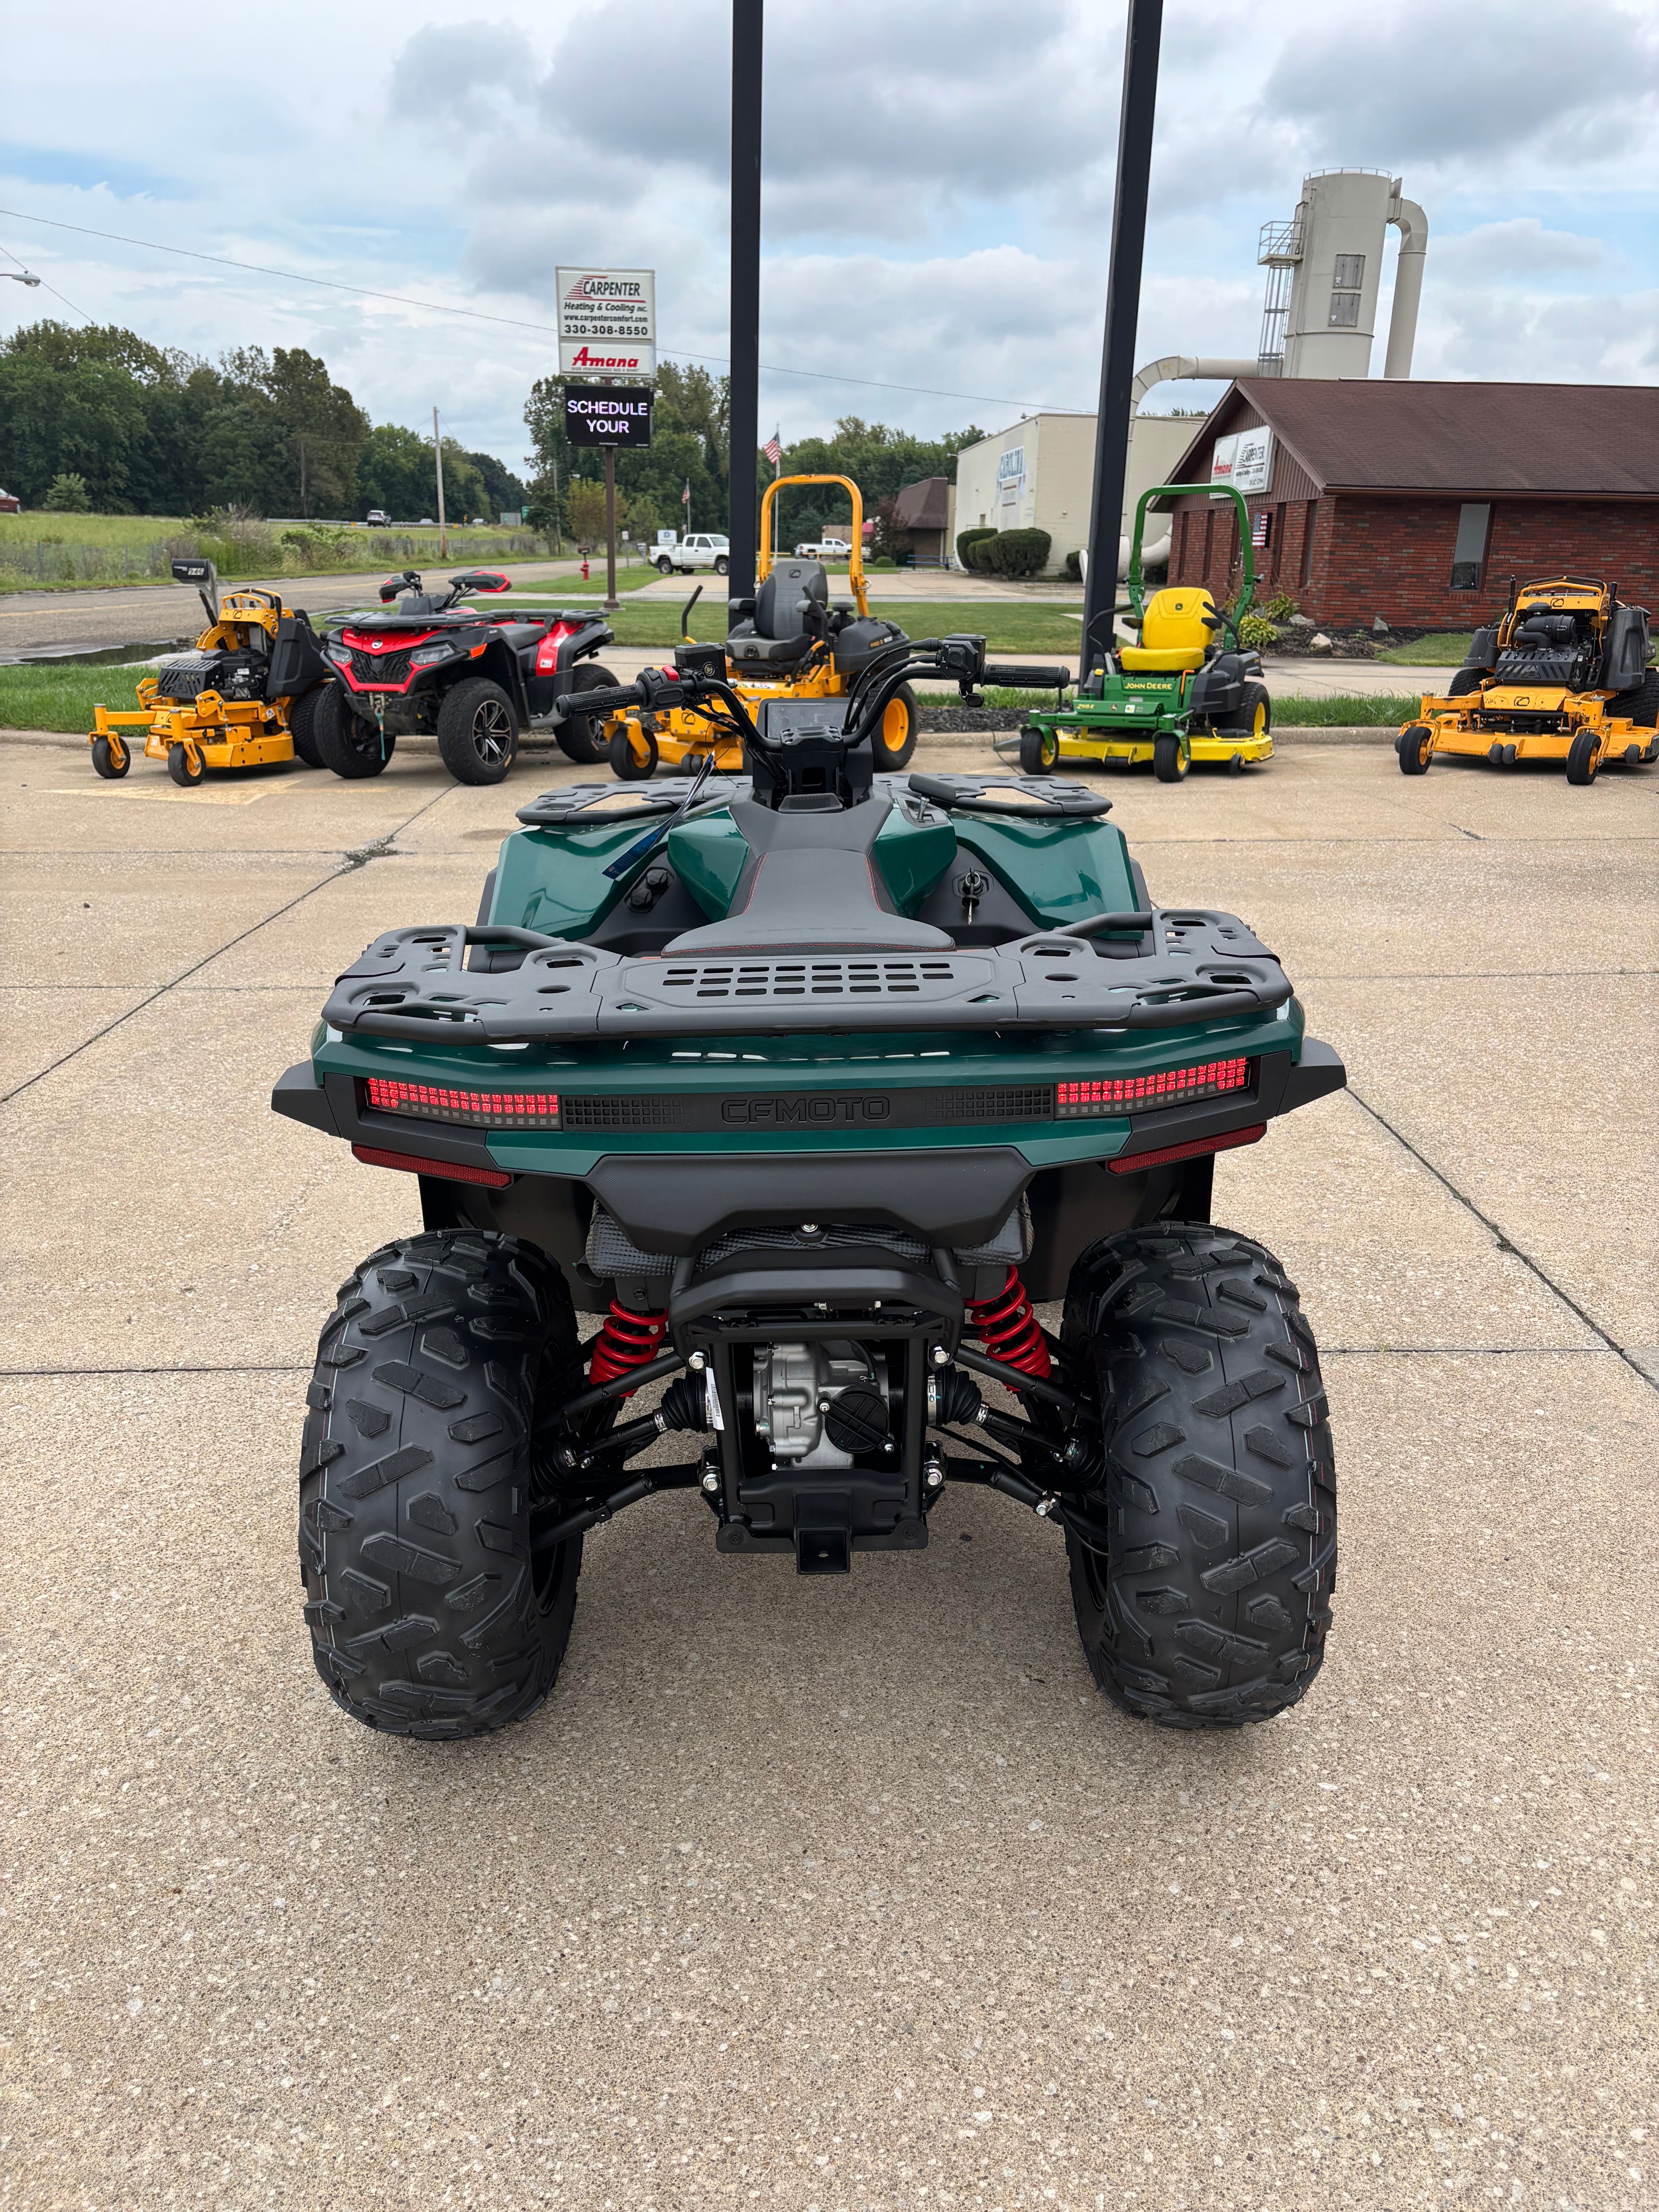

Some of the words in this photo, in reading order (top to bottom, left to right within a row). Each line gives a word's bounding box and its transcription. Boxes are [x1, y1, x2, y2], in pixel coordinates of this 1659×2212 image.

[583, 281, 640, 296] CARPENTER
[564, 302, 595, 313] Heating
[605, 303, 635, 313] Cooling
[572, 347, 639, 368] Amana
[567, 400, 648, 416] SCHEDULE
[586, 419, 630, 433] YOUR
[721, 1096, 890, 1124] CFMOTO
